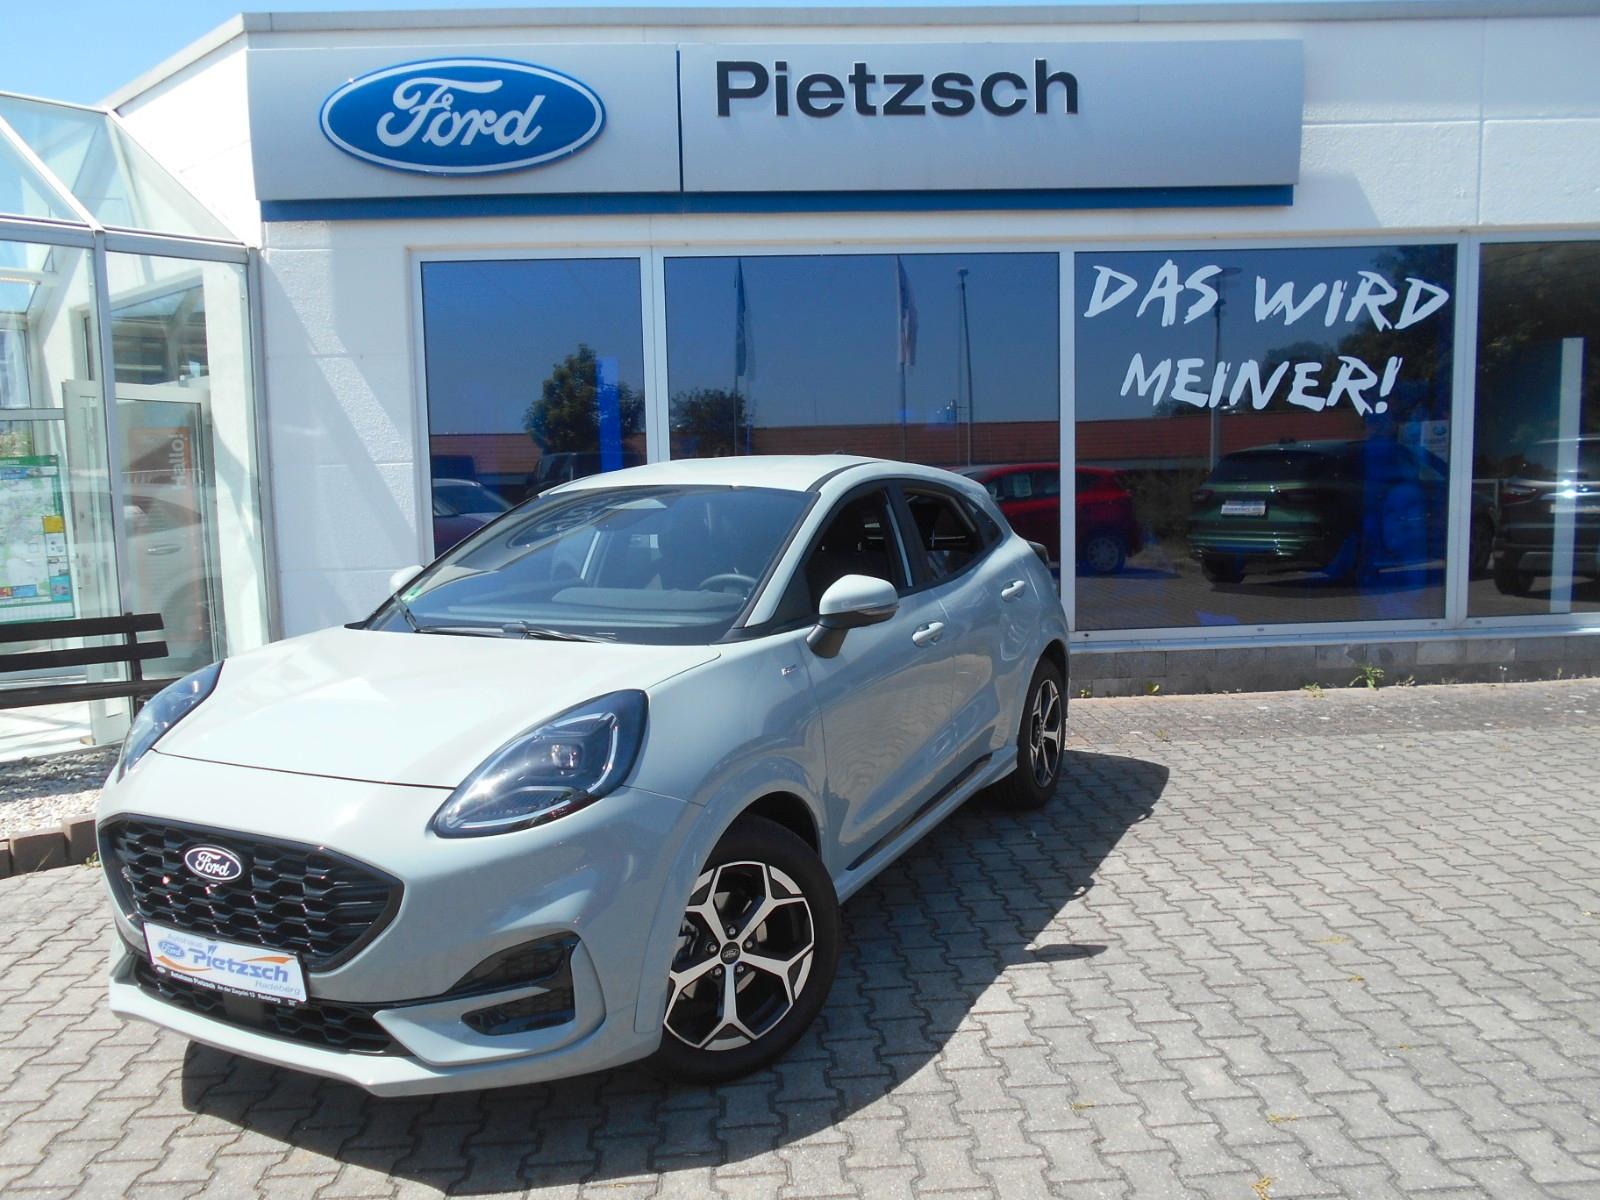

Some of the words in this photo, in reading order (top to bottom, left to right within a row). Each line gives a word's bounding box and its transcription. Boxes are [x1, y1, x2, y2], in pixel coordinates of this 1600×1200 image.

[376, 76, 545, 147] Ford
[716, 58, 1078, 118] Pietzsch
[1084, 259, 1222, 327] DAS
[1254, 270, 1449, 331] WIRD
[1120, 353, 1403, 416] MEINER!
[195, 851, 230, 877] Ford
[188, 945, 289, 983] Pietzsch
